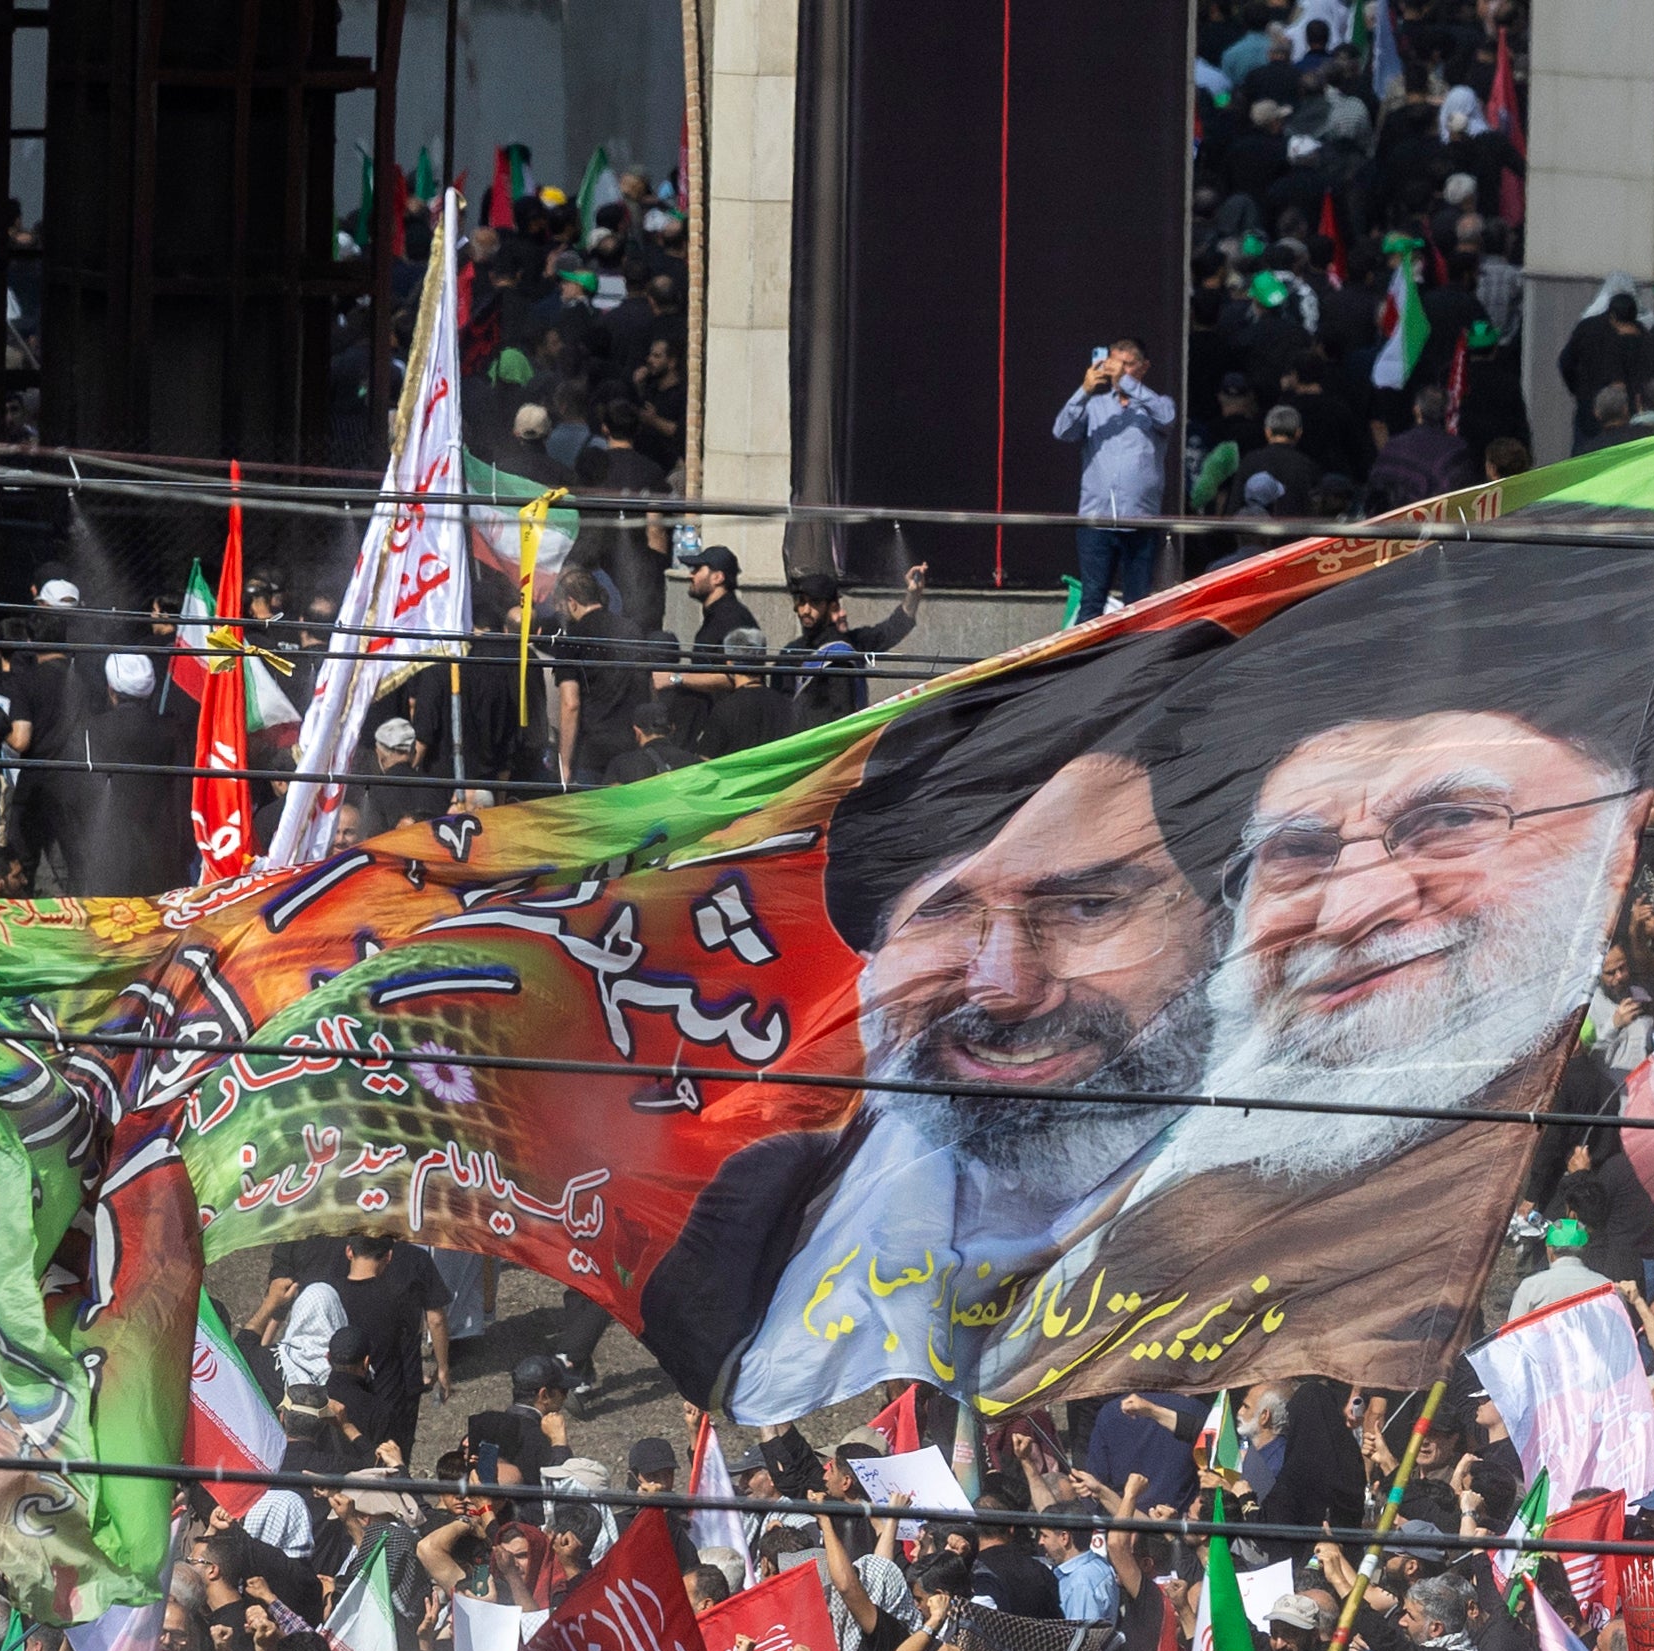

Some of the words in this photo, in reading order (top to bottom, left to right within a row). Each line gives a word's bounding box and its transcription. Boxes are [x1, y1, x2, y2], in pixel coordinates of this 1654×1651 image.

[340, 1142, 407, 1210] سید
[411, 1140, 483, 1232] امام
[509, 1168, 610, 1275] لبیک
